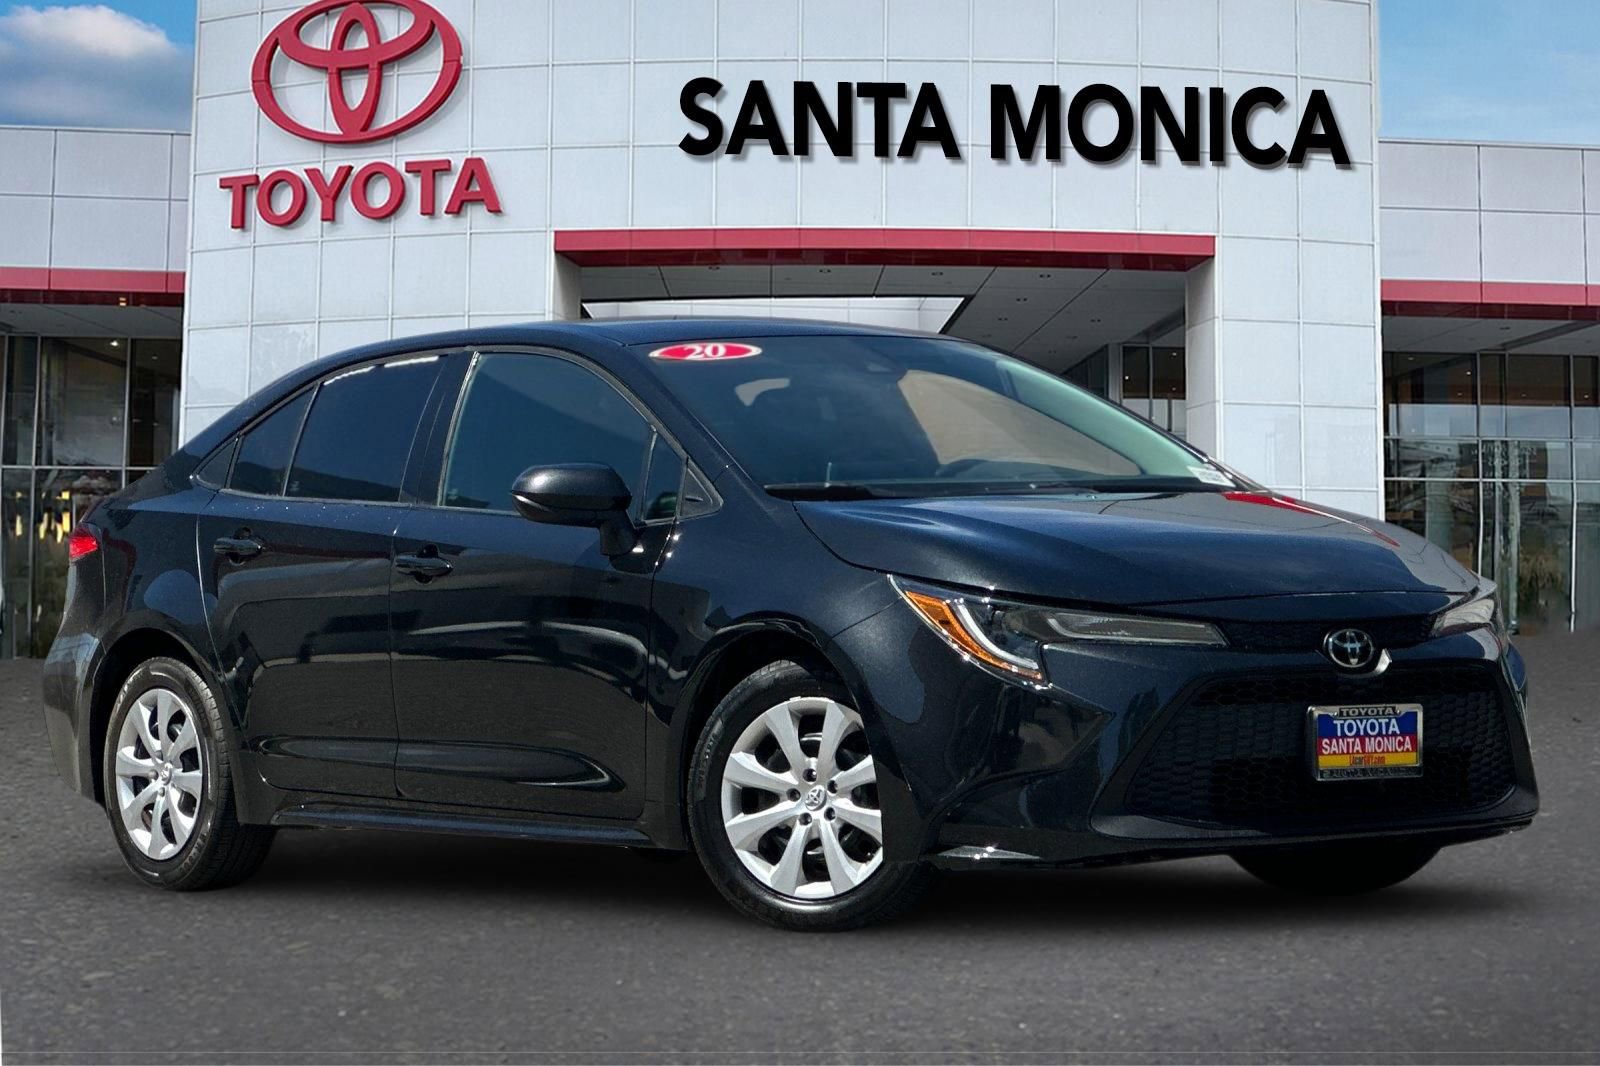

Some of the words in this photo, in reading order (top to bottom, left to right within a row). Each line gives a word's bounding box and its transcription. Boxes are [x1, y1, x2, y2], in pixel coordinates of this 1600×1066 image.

[679, 76, 961, 159] SANTA
[990, 83, 1351, 168] MONICA
[219, 157, 503, 229] TOYOTA
[683, 343, 726, 359] 20
[1341, 707, 1394, 716] TOYOTA
[1333, 718, 1400, 736] TOYOTA
[1322, 738, 1362, 754] SANTA
[1366, 736, 1412, 753] MONICA
